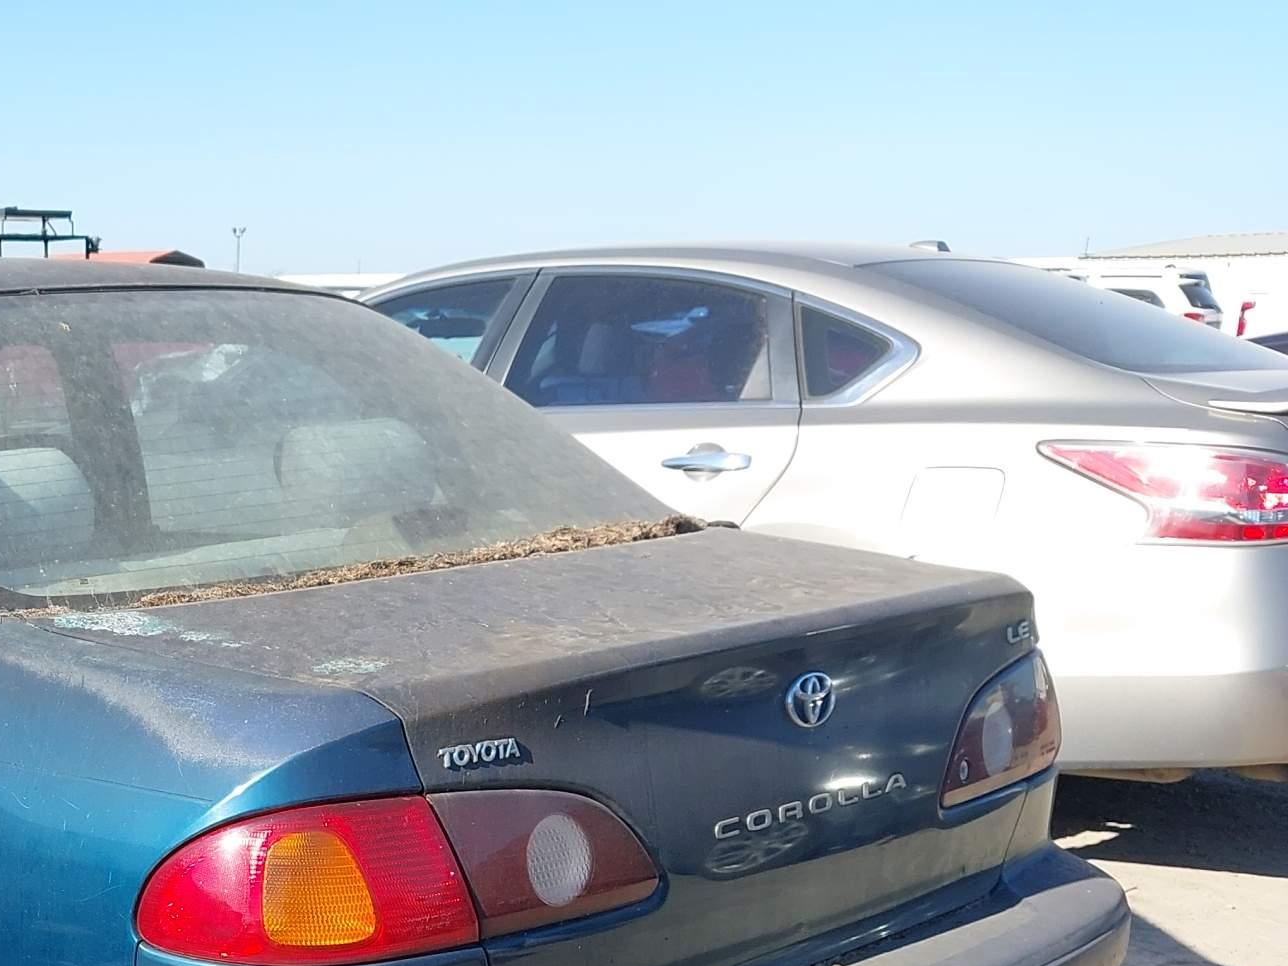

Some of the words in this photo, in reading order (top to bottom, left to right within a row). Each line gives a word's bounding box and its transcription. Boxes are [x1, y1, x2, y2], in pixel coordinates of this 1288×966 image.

[1007, 621, 1030, 644] LE
[437, 737, 521, 769] TOYOTA
[714, 773, 907, 840] COROLLA
